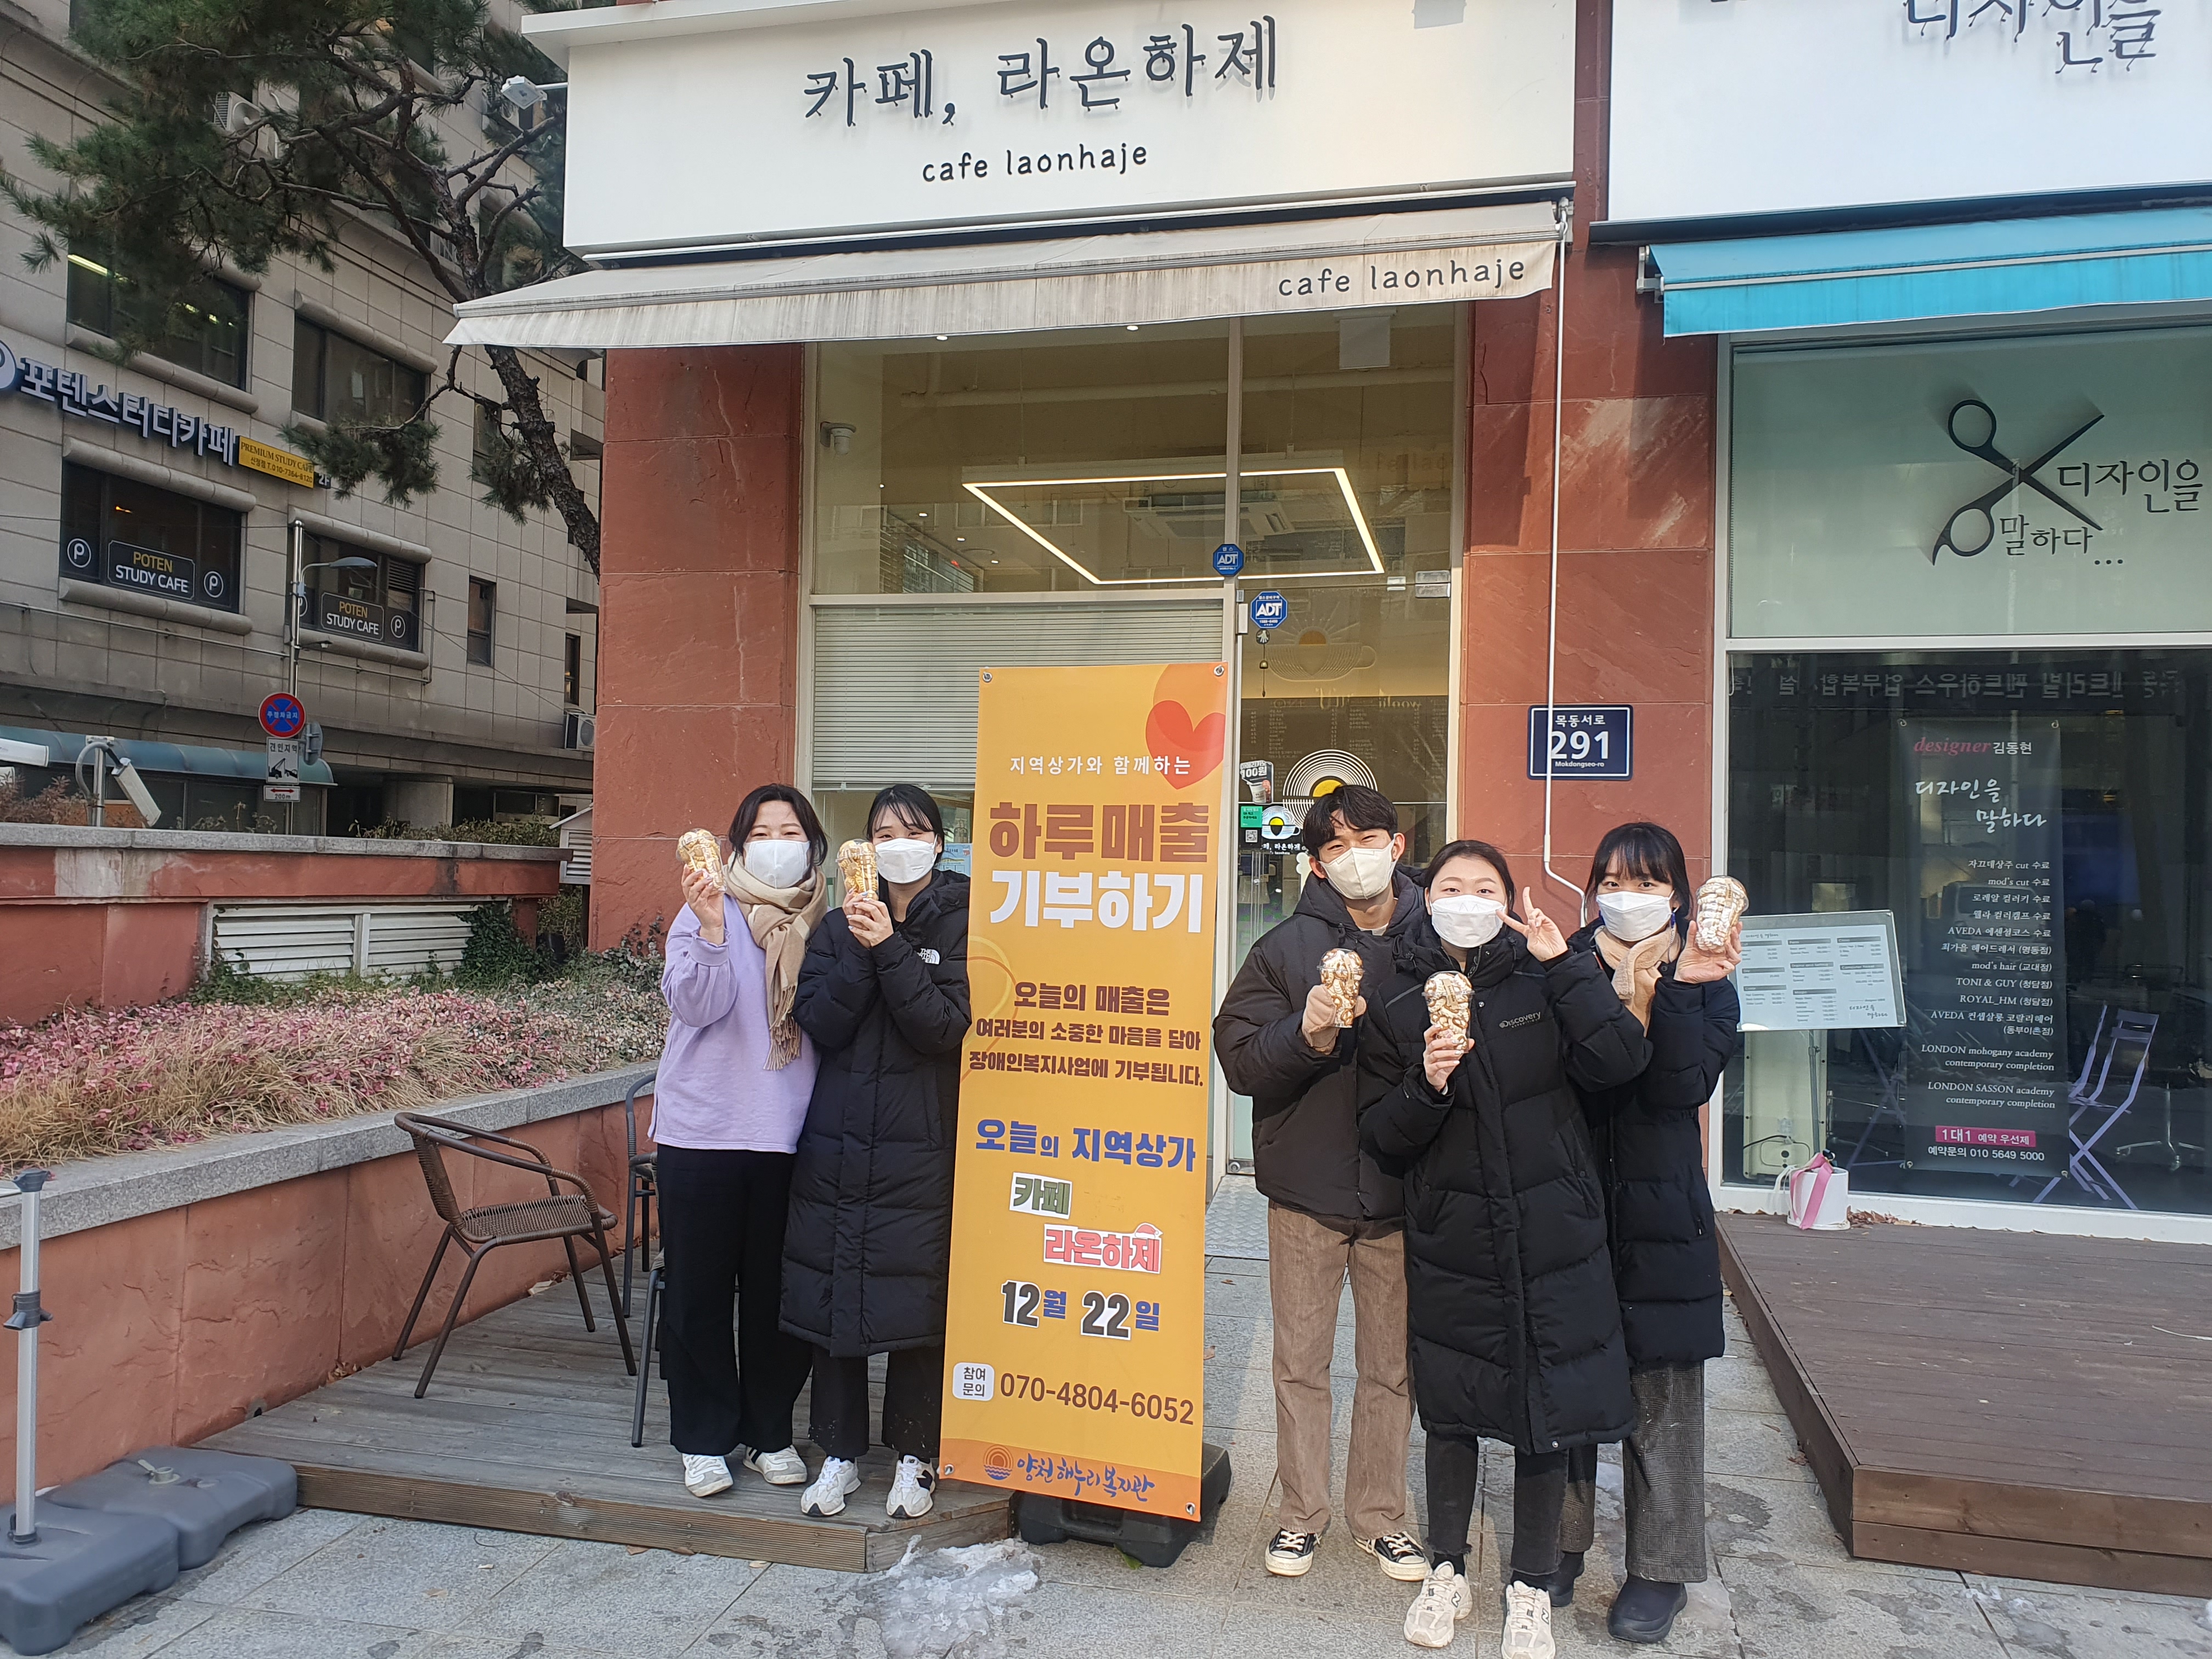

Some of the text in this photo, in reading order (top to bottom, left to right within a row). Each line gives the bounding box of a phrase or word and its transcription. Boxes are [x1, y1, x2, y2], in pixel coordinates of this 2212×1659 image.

[804, 15, 1277, 128] 카페, 라온하제
[922, 143, 1149, 183] cafe laonhaje
[1278, 257, 1526, 298] cafe laonhaje
[20, 357, 235, 466] 포텐스터디카페
[241, 442, 274, 460] PREMIUM
[275, 454, 297, 468] STUDY
[2057, 459, 2203, 514] 디자인을
[133, 551, 173, 573] POTEN
[1217, 553, 1238, 565] ADT
[115, 564, 189, 594] STUDY CAFE
[339, 600, 369, 619] POTEN
[1256, 602, 1282, 617] ADT
[326, 612, 379, 636] STUDY CAFE
[1555, 714, 1606, 728] 목동서로
[1551, 730, 1609, 760] 291
[1914, 737, 2032, 755] designer 김동현
[1009, 755, 1191, 775] 지역상가와 함께하는
[1555, 760, 1605, 769] Mokdongseo-ro
[1915, 778, 2001, 803] 디자인을
[1976, 807, 2047, 833] 말하다
[989, 802, 1209, 862] 하루매출
[2031, 861, 2050, 870] 수료
[1988, 877, 2013, 885] mod's
[2032, 878, 2050, 887] 수료
[990, 870, 1203, 933] 기부하기
[1972, 893, 2051, 904] 로레알 컬러키 수료
[2033, 912, 2051, 920] 수료
[1948, 927, 1982, 935] AVEDA
[2033, 929, 2051, 938] 수료
[1971, 944, 2015, 954] 헤어드레서
[2018, 945, 2052, 955] (명동점)
[1971, 961, 2052, 972] mod's hair (교대점)
[1956, 978, 2053, 989] TONI & GUY (청담점)
[1014, 981, 1170, 1016] 오늘의 매출은
[1960, 995, 2053, 1007] ROYAL_HM (청담점)
[1499, 1011, 1542, 1028] Discovery
[1931, 1010, 1965, 1020] AVEDA
[976, 1017, 1201, 1051] 여러분의 소중한 마음을 담아
[2004, 1025, 2054, 1036] (동부이촌점)
[1921, 1044, 2054, 1060] LONDON mohogany academy
[969, 1051, 1204, 1087] 장애인복지사업에 기부됩니다.
[1945, 1059, 2055, 1071] contemporary completion
[1927, 1081, 2055, 1097] LONDON SASSON academy
[1946, 1097, 2056, 1109] contemporary completion
[975, 1119, 1197, 1172] 오늘의 지역상가
[1942, 1128, 2030, 1146] 1대1 예약 우선제
[1928, 1146, 2045, 1161] 예약문의 010 5649 5000
[1013, 1177, 1071, 1215] 카페
[1045, 1228, 1161, 1273] 라온하제
[963, 1366, 986, 1382] 참여
[962, 1383, 985, 1398] 문의
[1000, 1373, 1194, 1425] 070-4804-6052
